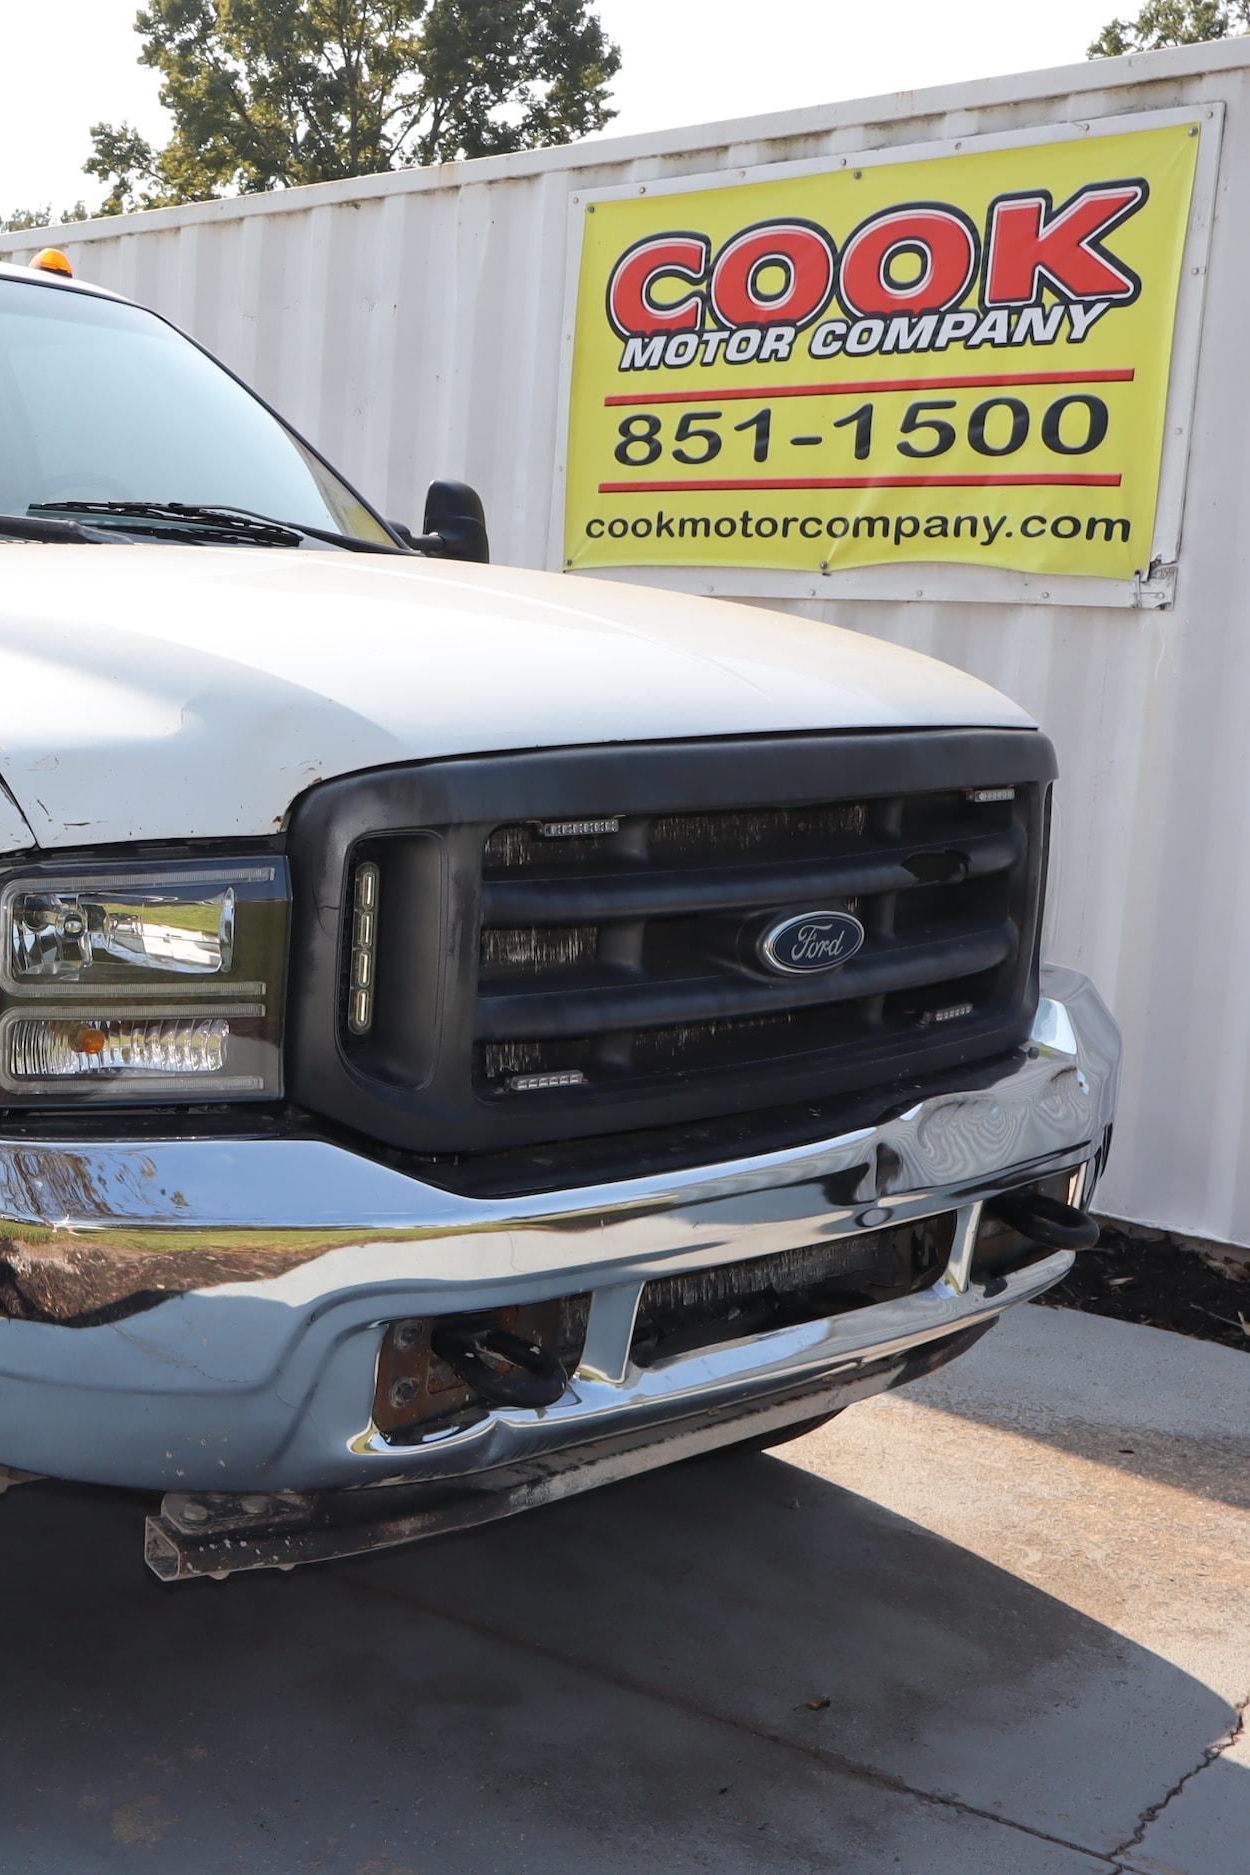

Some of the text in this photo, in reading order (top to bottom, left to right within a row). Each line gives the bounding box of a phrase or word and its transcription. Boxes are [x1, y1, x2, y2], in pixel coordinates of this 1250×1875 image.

[606, 177, 1150, 344] COOK
[619, 302, 1111, 372] MOTOR COMPANY
[613, 393, 1109, 467] 851-1500
[585, 510, 1131, 546] cookmotorcompany.com
[791, 923, 845, 961] Ford
